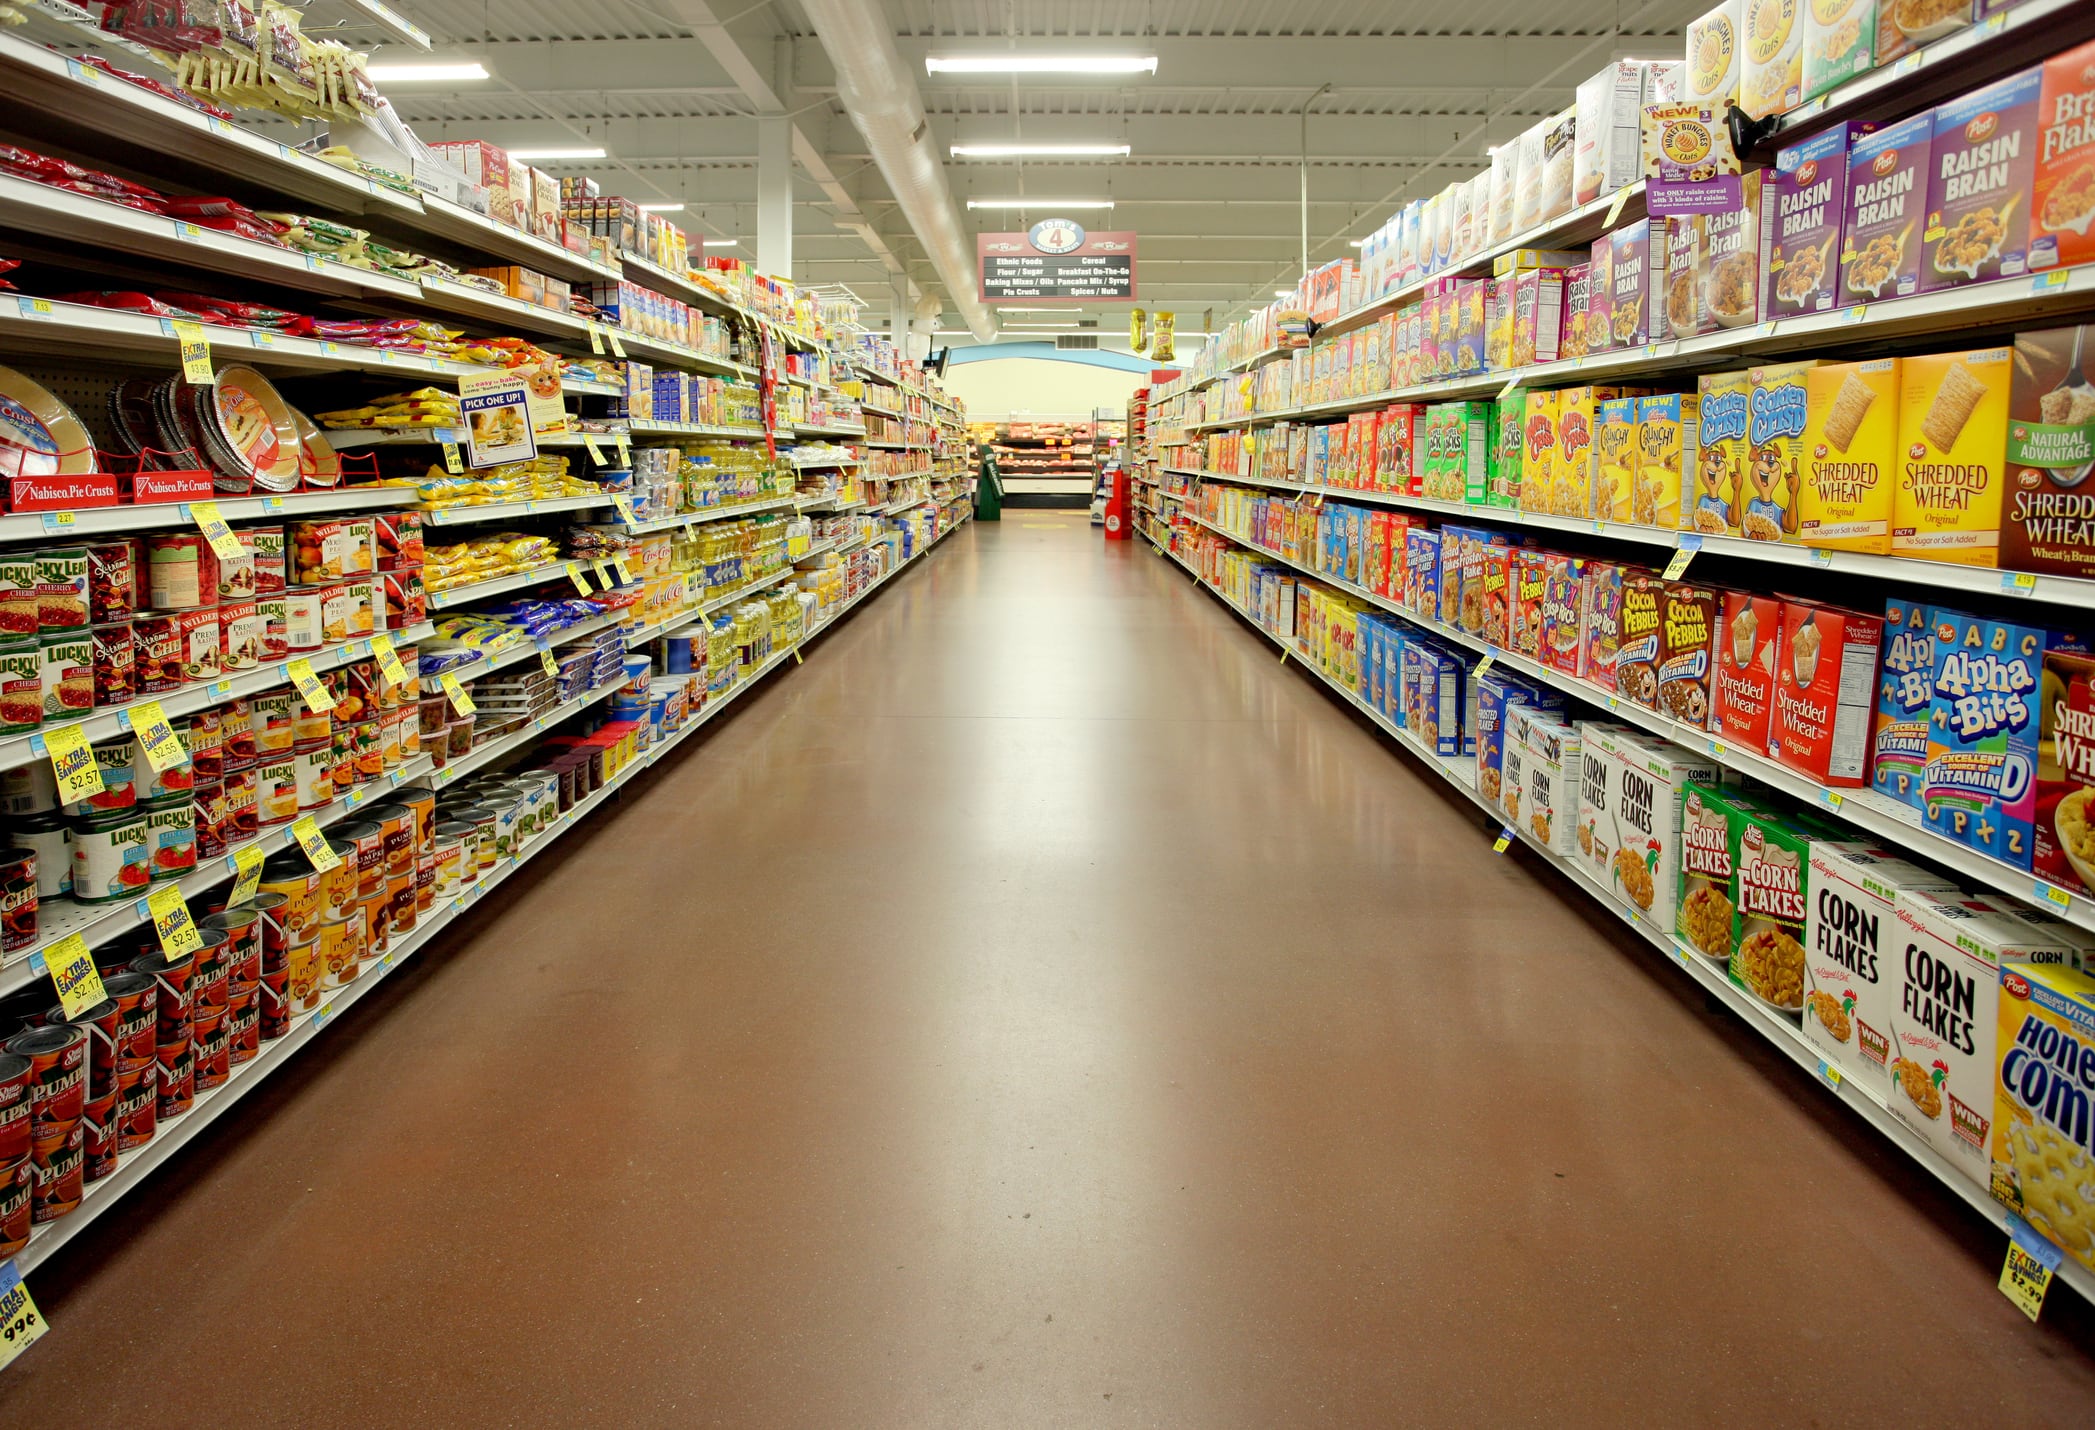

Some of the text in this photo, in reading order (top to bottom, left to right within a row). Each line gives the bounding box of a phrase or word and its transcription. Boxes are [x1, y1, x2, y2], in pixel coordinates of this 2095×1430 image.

[1759, 37, 1779, 58] Oats
[1644, 105, 1660, 114] TRY
[1652, 106, 1698, 119] NEW!
[1665, 124, 1707, 149] HONEY BUNCHES
[1680, 152, 1697, 161] Oats
[1941, 129, 2021, 179] RAISIN
[1854, 166, 1915, 207] RAISIN
[1945, 162, 2009, 201] BRAN
[1780, 178, 1832, 217] RAISIN
[1705, 207, 1751, 236] Raisin
[1783, 204, 1824, 237] BRAN
[1857, 195, 1904, 228] BRAN
[1050, 229, 1062, 246] 4
[1667, 224, 1698, 254] Raisin
[1709, 232, 1741, 256] Bran
[1022, 268, 1043, 276] Sugar
[1614, 256, 1642, 280] RAISIN
[1670, 251, 1692, 273] Bran
[1071, 288, 1094, 296] Spices
[1616, 275, 1638, 295] BRAN
[183, 342, 204, 356] EXTRA
[183, 349, 208, 363] SAVINGS!
[465, 393, 520, 409] PICK ONE UP!
[1604, 401, 1628, 410] NEW!
[1642, 397, 1674, 408] NEW!
[1752, 385, 1806, 412] Golden
[1, 406, 36, 425] Crust
[1600, 429, 1629, 451] CRUNCHY
[1639, 423, 1675, 450] CRUNCHY
[2031, 430, 2086, 447] NATURAL
[1606, 444, 1618, 457] NUT
[1647, 443, 1661, 457] NUT
[1910, 446, 1924, 457] Post
[2020, 444, 2092, 461] ADVANTAGE
[177, 481, 188, 492] Pie
[189, 480, 211, 491] Crusts
[1809, 462, 1878, 486] SHREDDED
[1902, 462, 1988, 490] SHREDDED
[2021, 473, 2038, 484] Post
[30, 483, 114, 500] Nabisco Pie Crusts
[1818, 481, 1875, 505] WHEAT
[1914, 487, 1983, 511] WHEAT
[1827, 507, 1854, 519] Original
[1924, 513, 1959, 527] Original
[1915, 537, 1933, 546] Sugar
[1941, 535, 1953, 543] Salt
[1953, 535, 1977, 543] Added
[38, 584, 72, 592] CHERRY
[1626, 589, 1656, 610] COCOA
[1623, 608, 1659, 635] PEBBLES
[1668, 600, 1704, 622] COCOA
[1665, 620, 1708, 649] PEBBLES
[1845, 625, 1877, 635] Shredded
[1938, 627, 1952, 638] Post
[1964, 625, 2037, 656] A B C
[1719, 669, 1764, 700] Shredded
[1936, 651, 2034, 697] Alpha
[1724, 687, 1756, 715] Wheat
[1777, 688, 1827, 724] Shredded
[140, 721, 166, 744] EXTRA
[1726, 713, 1751, 730] Original
[1782, 714, 1817, 740] Wheat
[153, 742, 178, 759] $2.55
[1784, 736, 1812, 757] Original
[55, 746, 86, 772] EXTRA
[1507, 750, 1521, 773] CORN
[1583, 752, 1607, 790] CORN
[1941, 754, 2004, 765] EXCELLENT
[70, 770, 100, 790] $2.57
[1506, 765, 1520, 786] FLAKES
[1532, 768, 1550, 793] CORN
[1688, 770, 1711, 779] CORN
[1531, 784, 1550, 808] FLAKES
[1581, 779, 1606, 811] FLAKES
[1622, 769, 1654, 811] CORN
[1620, 797, 1653, 835] FLAKES
[1691, 822, 1726, 851] CORN
[1681, 832, 1732, 876] FLAKES
[1749, 859, 1797, 893] CORN
[1737, 868, 1806, 920] FLAKES
[157, 907, 183, 932] EXTRA
[1819, 888, 1878, 953] CORN
[172, 928, 196, 947] $2.57
[1817, 923, 1879, 984] FLAKES
[2031, 952, 2063, 964] CORN
[55, 956, 87, 988] EXTRA
[1904, 943, 1976, 1021] CORN
[73, 976, 100, 999] $2.17
[2006, 977, 2027, 994] Post
[1903, 981, 1976, 1056] FLAKES
[1859, 1027, 1884, 1046] WIN
[1953, 1102, 1982, 1129] WIN
[2008, 1260, 2047, 1288] SAVINGS!
[2010, 1249, 2044, 1275] EXTRA
[2010, 1271, 2042, 1303] $2.99
[4, 1312, 36, 1341] 99¢
